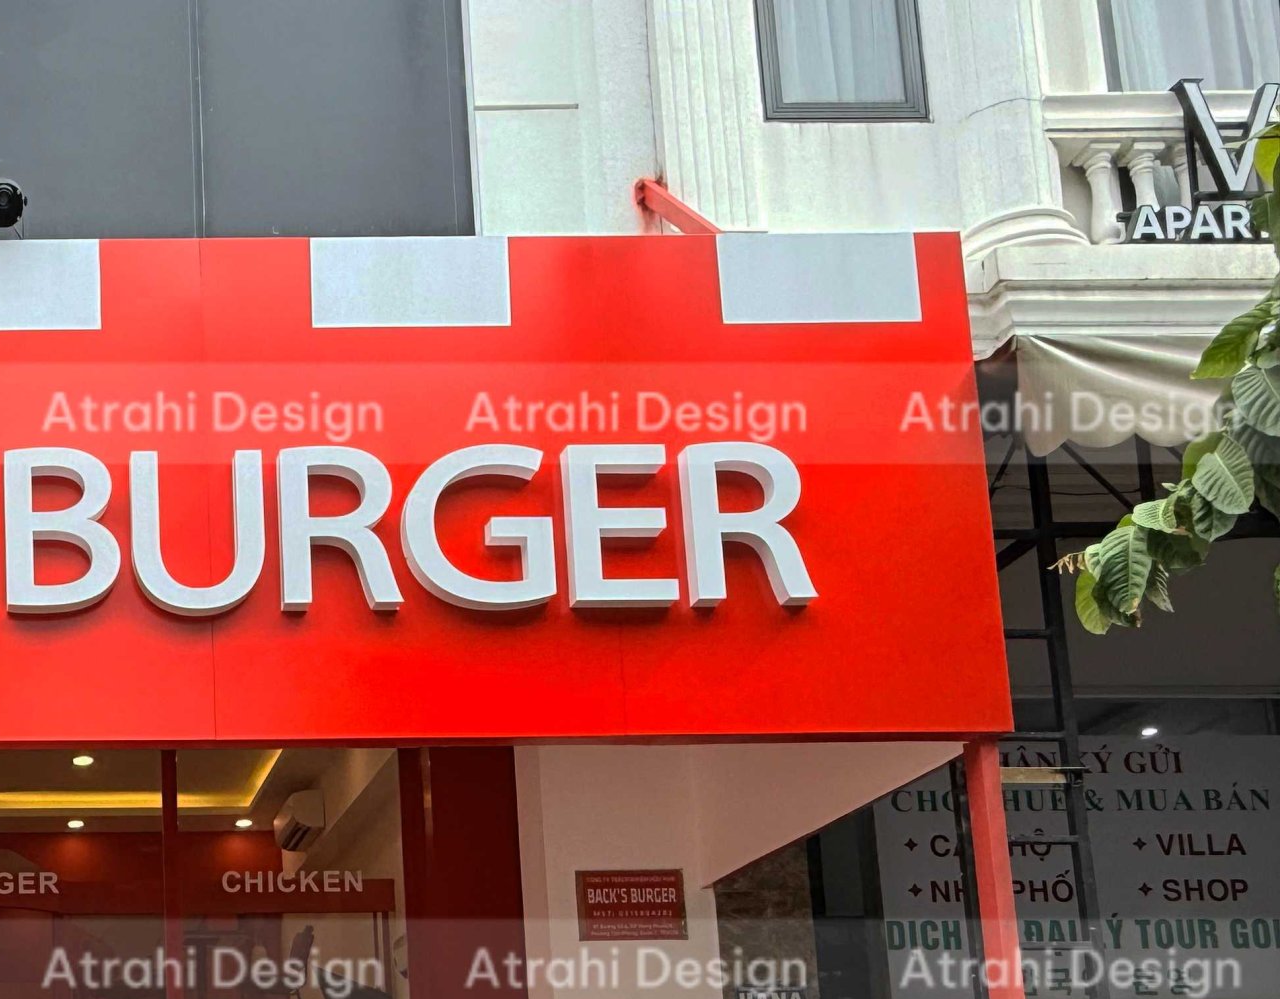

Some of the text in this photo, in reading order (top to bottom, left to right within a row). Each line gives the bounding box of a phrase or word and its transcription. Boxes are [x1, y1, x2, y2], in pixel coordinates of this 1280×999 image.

[1131, 203, 1254, 240] APAR
[3, 441, 818, 619] BURGER
[1002, 783, 1066, 812] HUÊ
[1117, 788, 1196, 812] MUA
[1202, 782, 1271, 812] BÁN
[1155, 833, 1248, 857] VILLA
[220, 869, 364, 894] CHICKEN
[1162, 879, 1249, 902] SHOP
[587, 887, 677, 904] BACK'S BURGER
[1134, 917, 1220, 950] TOUR
